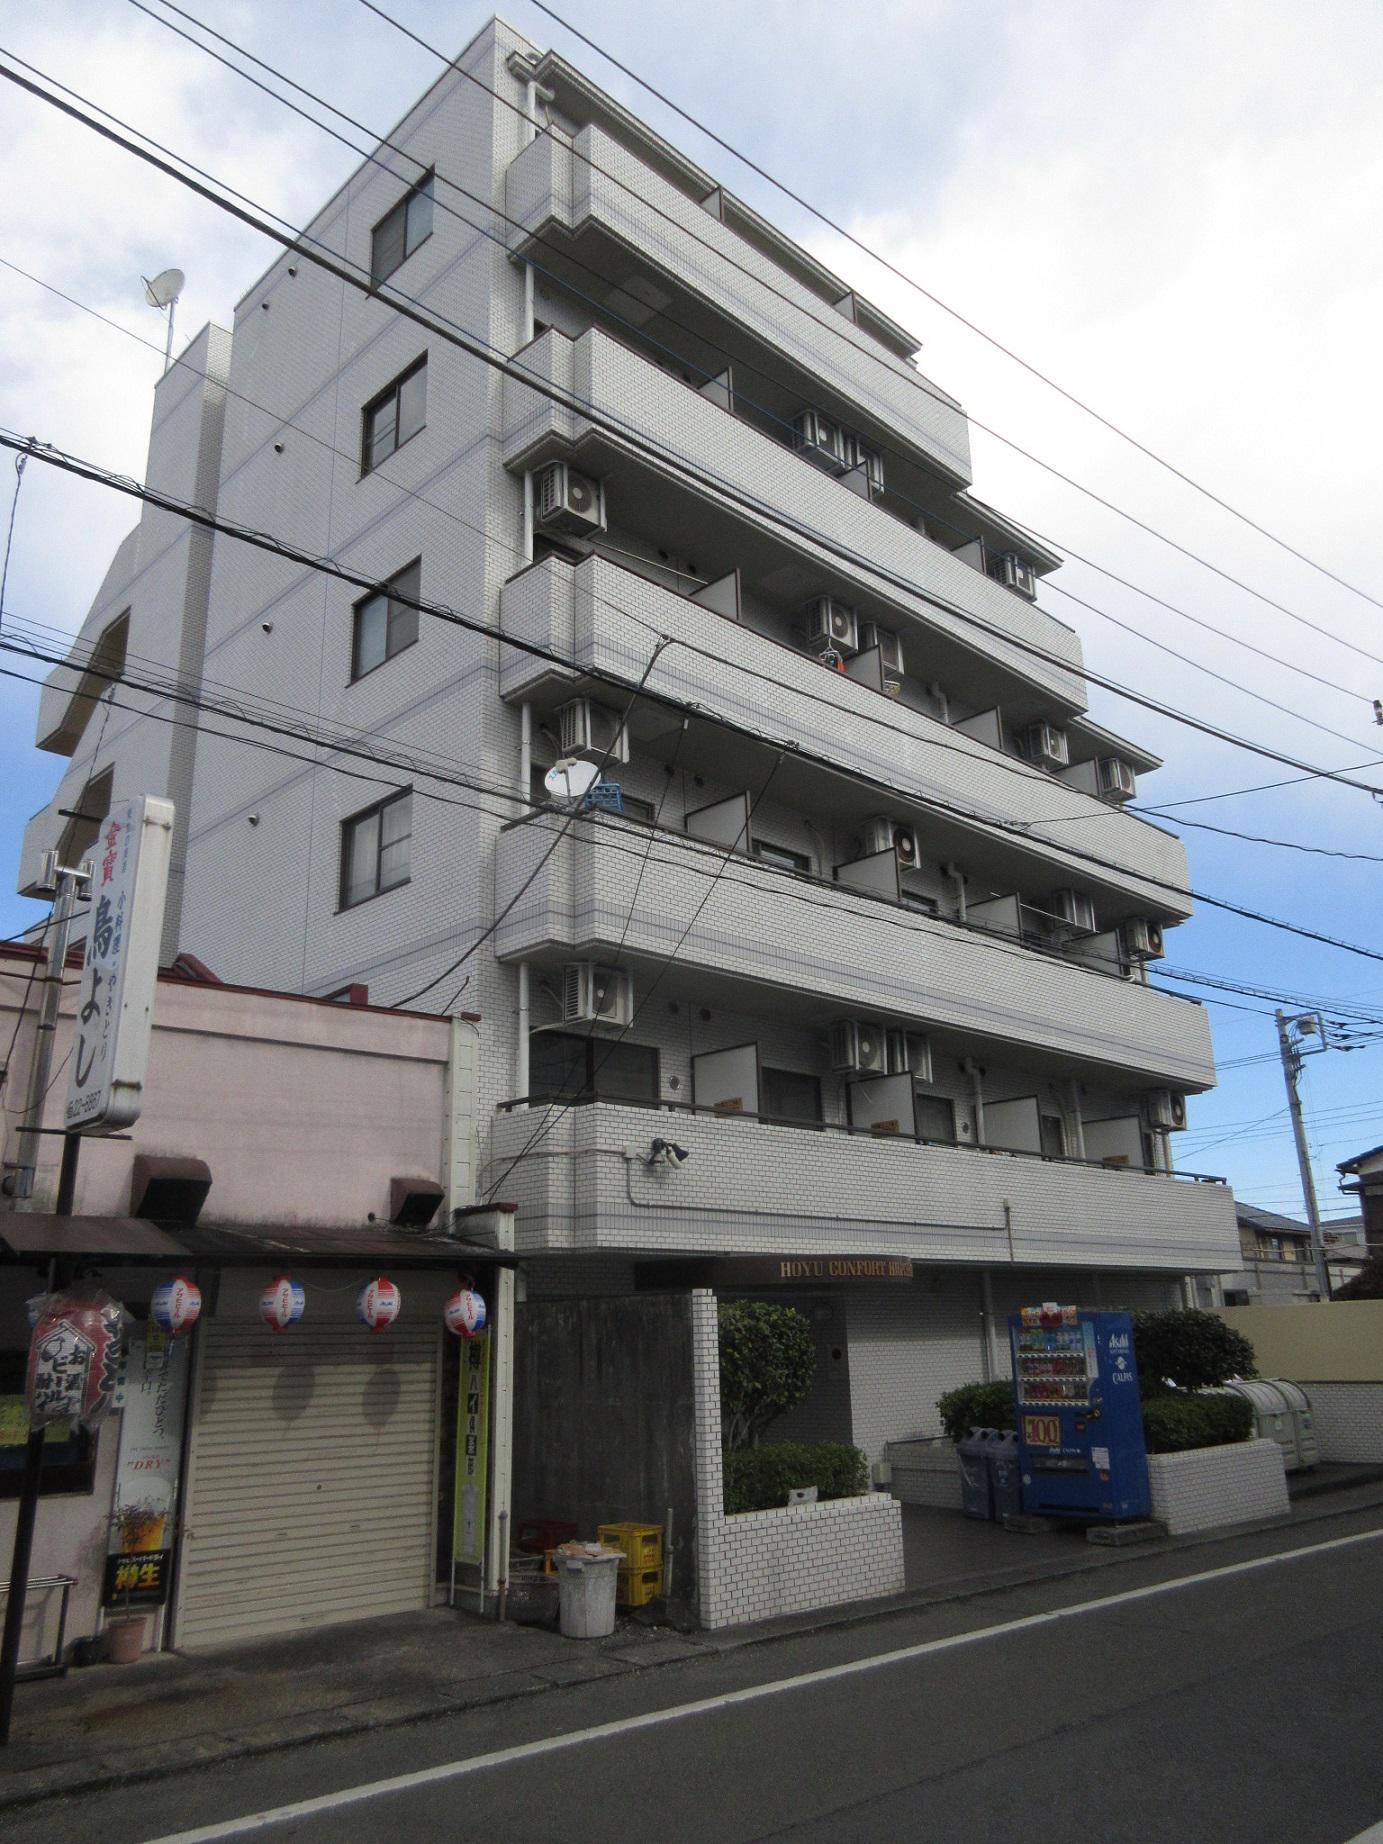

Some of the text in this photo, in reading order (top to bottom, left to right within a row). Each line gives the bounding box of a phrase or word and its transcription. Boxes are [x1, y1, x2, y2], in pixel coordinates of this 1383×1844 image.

[75, 894, 114, 1088] 鳥よし
[781, 1262, 824, 1277] HOYU
[829, 1260, 886, 1276] CONFORT
